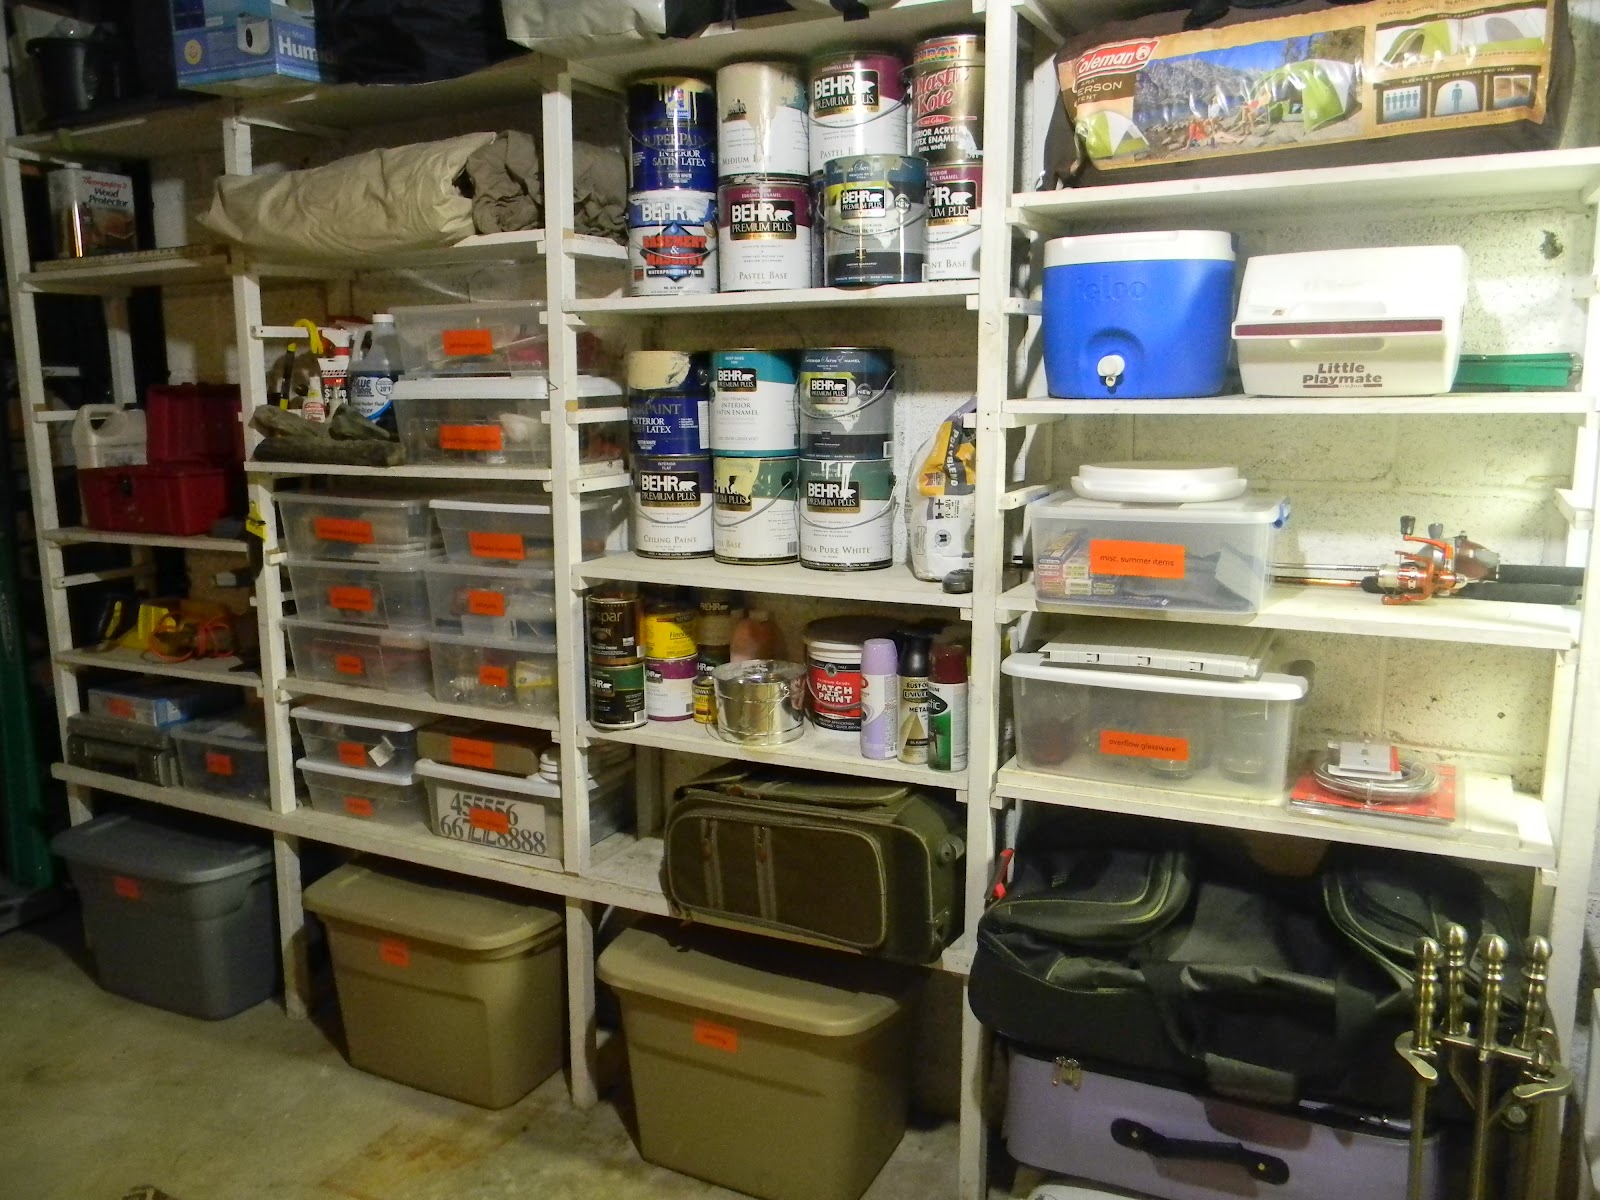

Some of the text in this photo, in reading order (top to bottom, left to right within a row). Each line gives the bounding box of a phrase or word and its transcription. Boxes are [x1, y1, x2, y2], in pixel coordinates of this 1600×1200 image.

[814, 74, 854, 99] BEHR
[1078, 81, 1122, 96] ERSON
[815, 94, 875, 110] PREMIUM PUS
[658, 149, 701, 158] INTERIOR
[652, 158, 707, 167] SATIN LATEX
[843, 190, 870, 204] BEHR
[842, 202, 867, 210] PREMIUM
[895, 200, 910, 208] NEW
[642, 202, 685, 222] BEHR
[731, 202, 775, 223] BEHR
[948, 205, 971, 216] PLUS
[732, 222, 793, 232] PREMIUM PLUS
[946, 259, 967, 268] BASE
[739, 271, 788, 280] PASTEL BASE
[1317, 362, 1365, 374] Little
[718, 369, 742, 382] BEHR
[1302, 373, 1382, 385] Playmate
[719, 380, 754, 388] PREMIUM PLUS
[811, 379, 835, 391] BEHR
[632, 417, 665, 426] INTERIOR
[646, 425, 672, 434] LATEX
[641, 474, 679, 492] BEHR
[641, 491, 697, 501] PREMIUM PLUS
[807, 483, 840, 498] BEHR
[807, 498, 856, 507] PREMIUM PLUS
[643, 534, 697, 544] CEILING PAINT
[726, 540, 741, 549] BASE
[819, 545, 839, 554] PURE
[842, 546, 870, 554] WHITE
[1100, 555, 1174, 567] misc. summer items
[816, 682, 853, 695] PATCH
[818, 691, 853, 704] PAINT
[1108, 739, 1176, 752] overflow glassware
